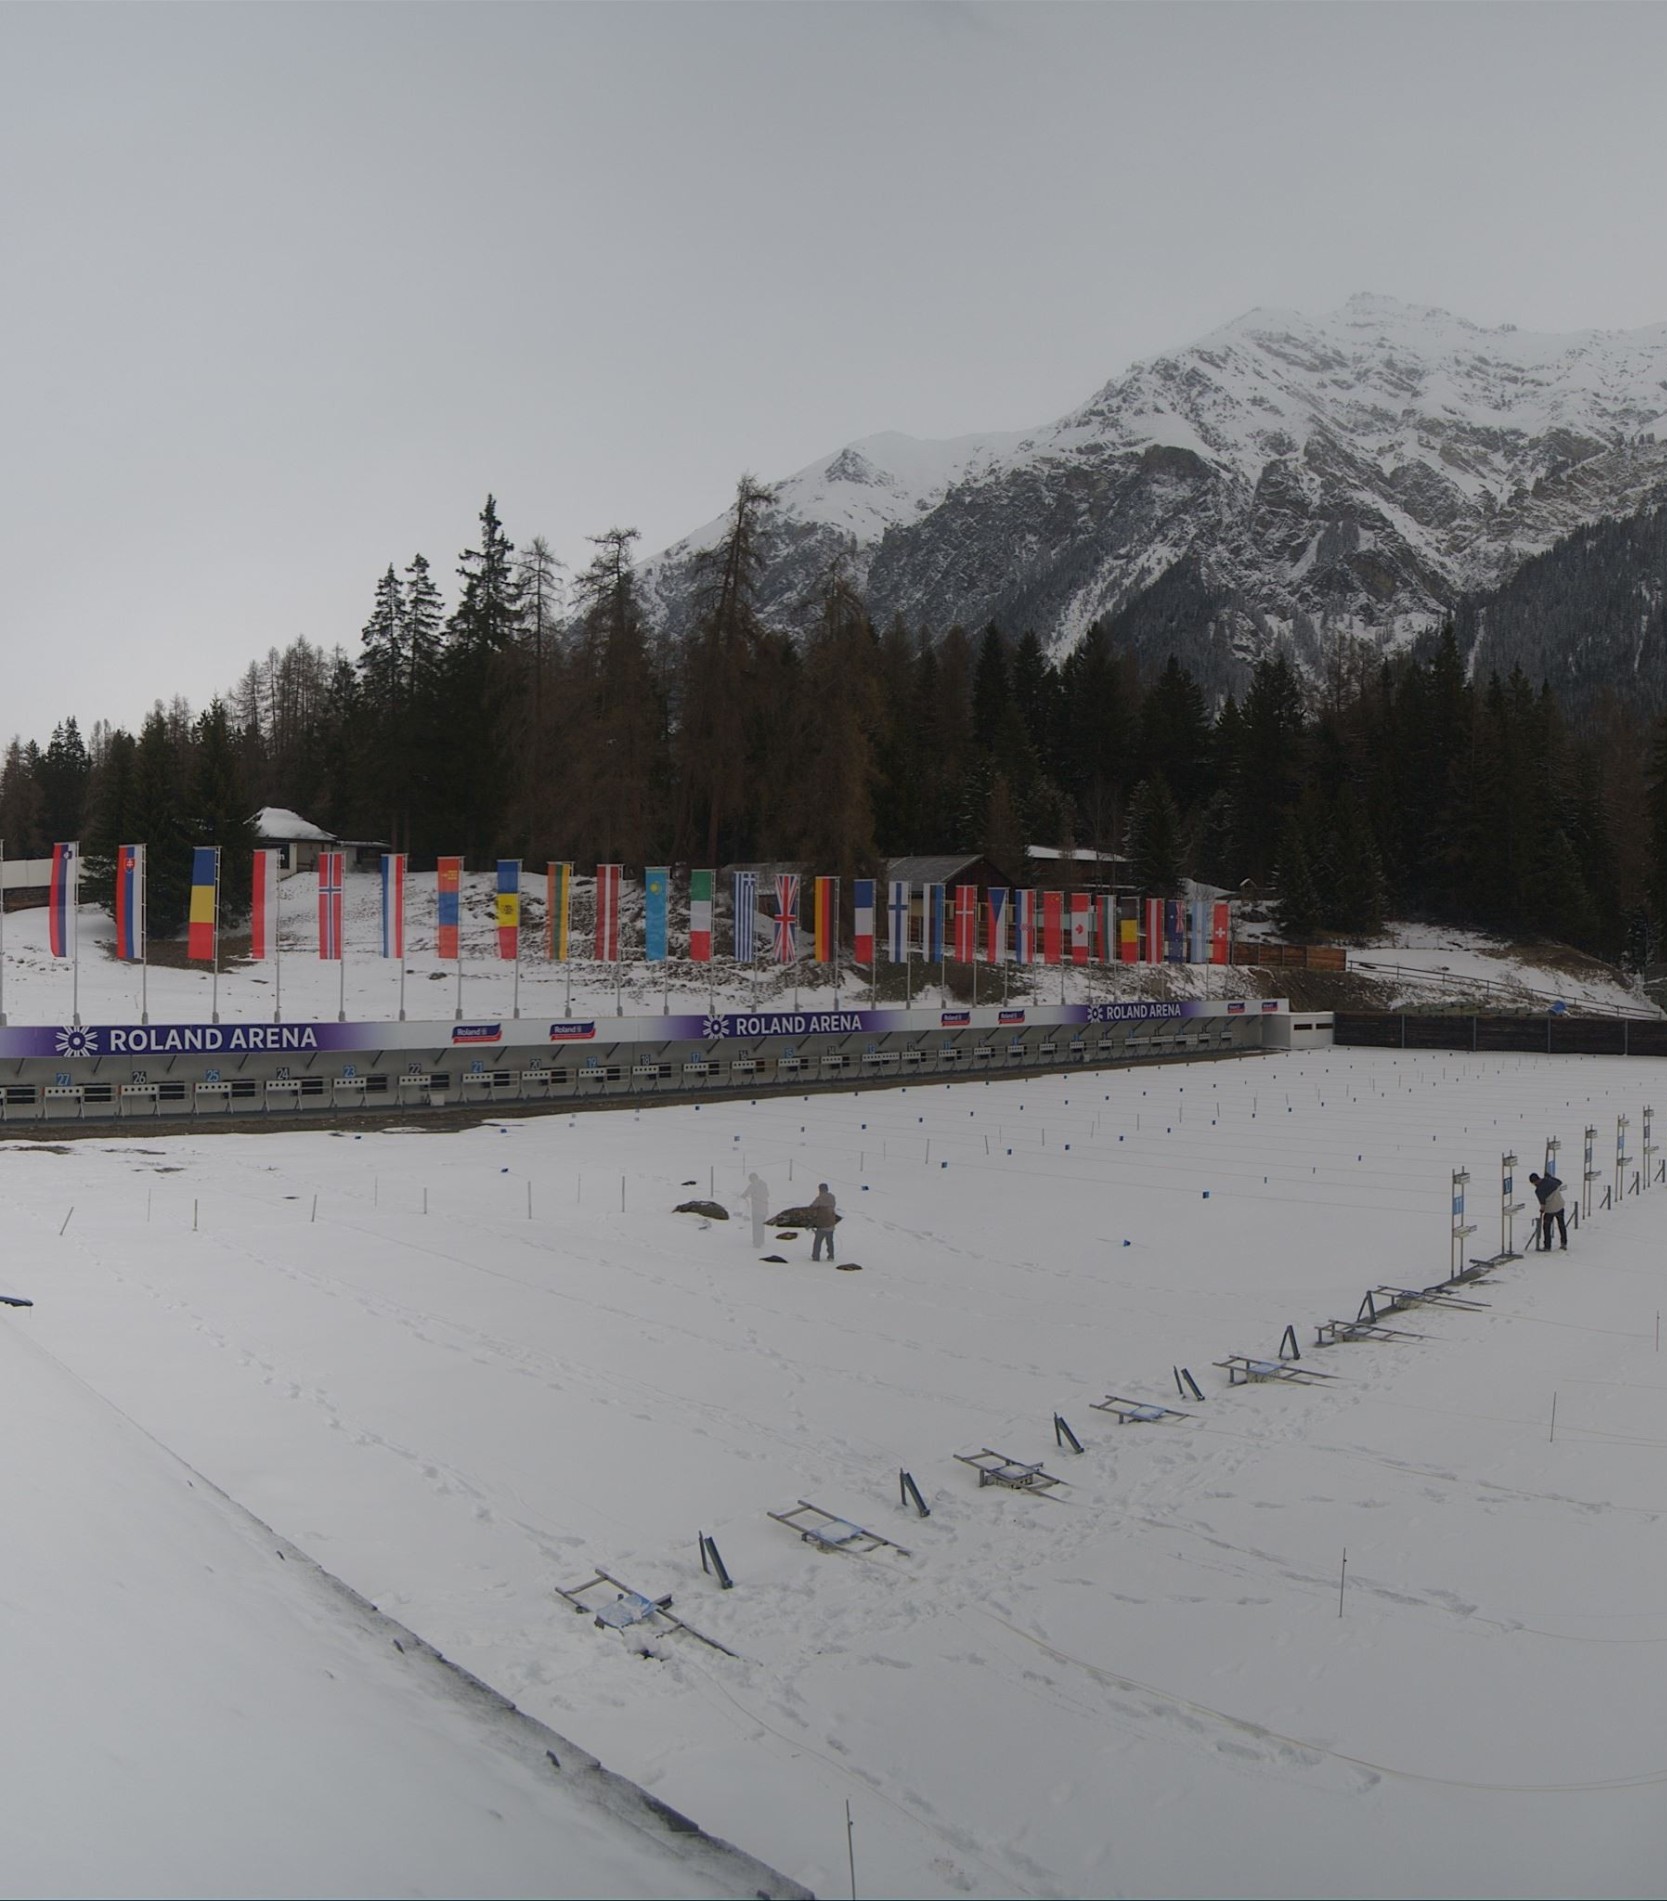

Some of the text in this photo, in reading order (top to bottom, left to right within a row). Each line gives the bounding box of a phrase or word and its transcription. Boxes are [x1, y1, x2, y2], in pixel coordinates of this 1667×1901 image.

[1107, 1003, 1181, 1020] ROLAND ARENA
[736, 1015, 862, 1035] ROLAND ARENA
[109, 1026, 318, 1052] ROLAND ARENA
[278, 1068, 289, 1080] 24
[345, 1066, 356, 1077] 23
[410, 1064, 421, 1075] 22
[59, 1074, 71, 1086] 27
[135, 1072, 148, 1084] 26
[207, 1070, 220, 1082] 25
